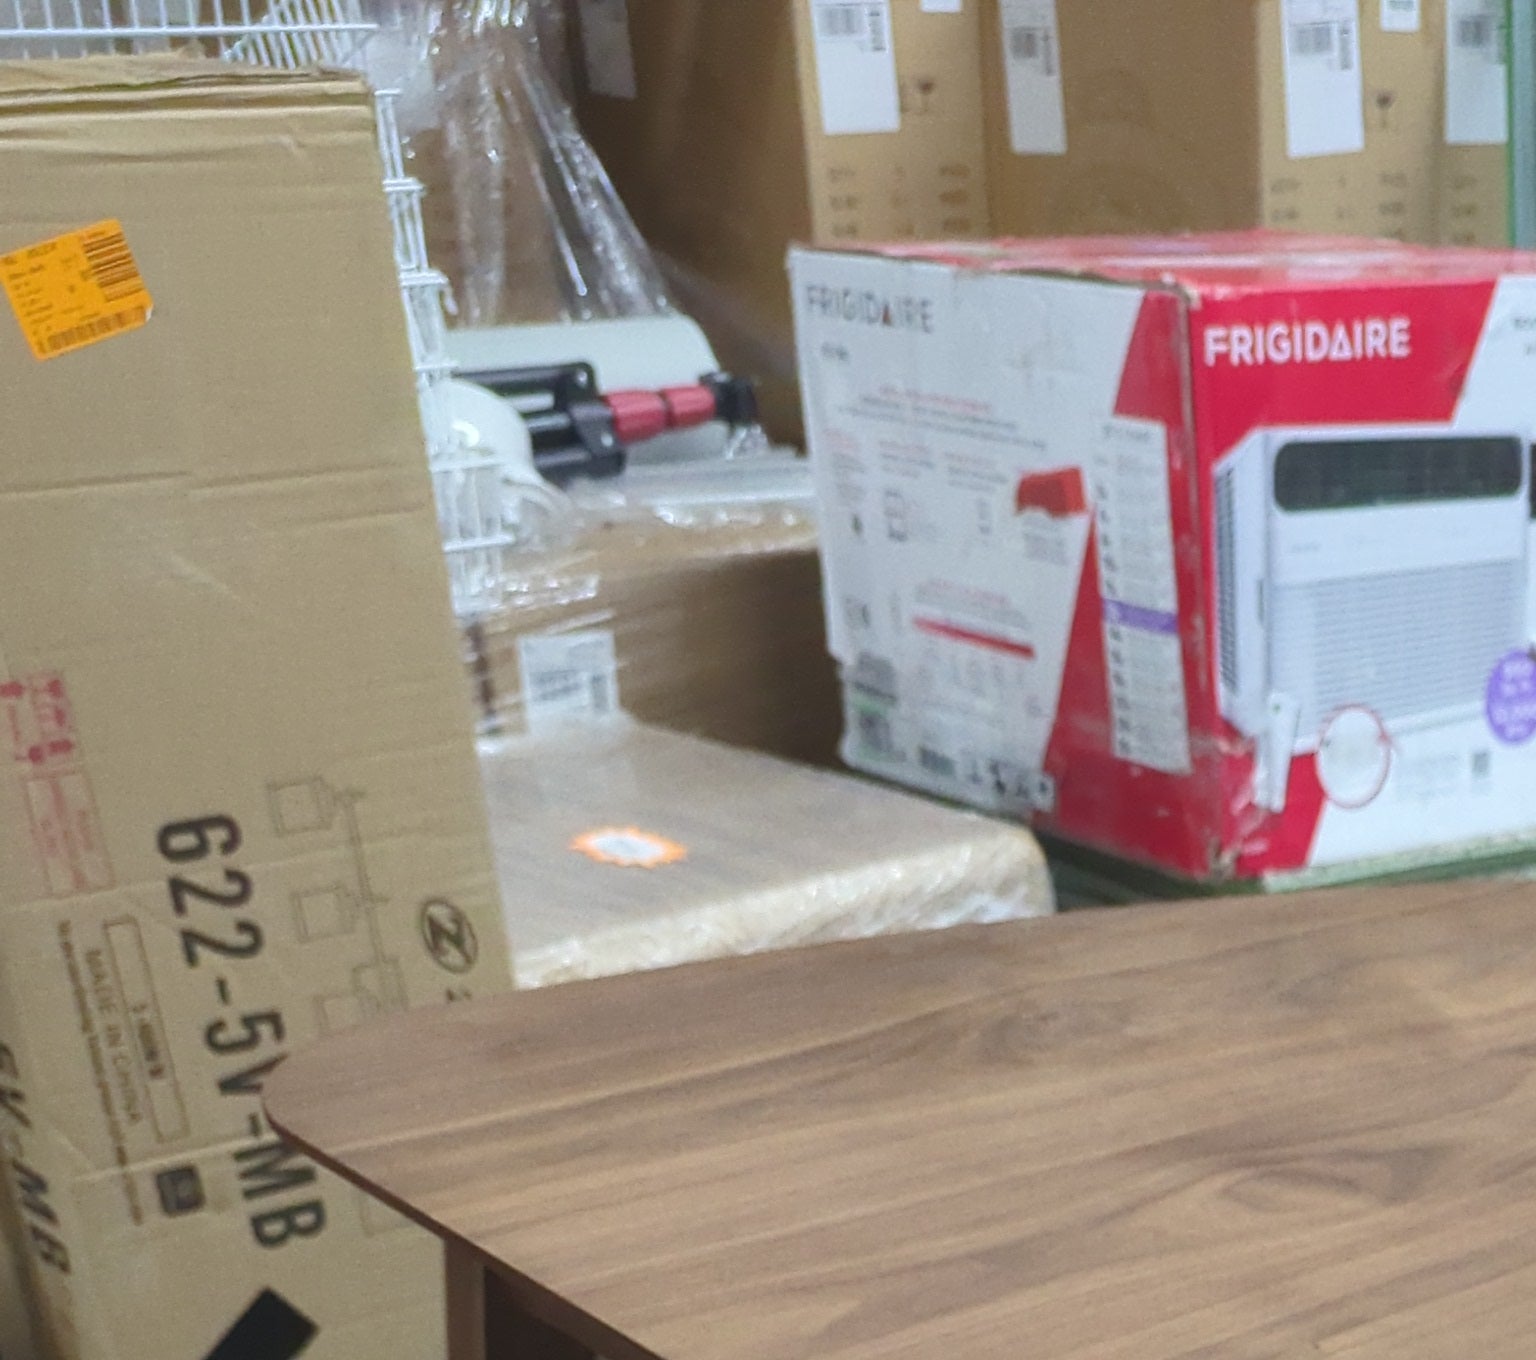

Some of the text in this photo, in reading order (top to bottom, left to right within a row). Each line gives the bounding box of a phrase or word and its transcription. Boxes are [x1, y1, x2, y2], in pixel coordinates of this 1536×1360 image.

[806, 285, 934, 333] FRIGIDAIRE
[1203, 314, 1411, 368] FRIGIDAIRE
[156, 813, 326, 1249] 622-5V-MB
